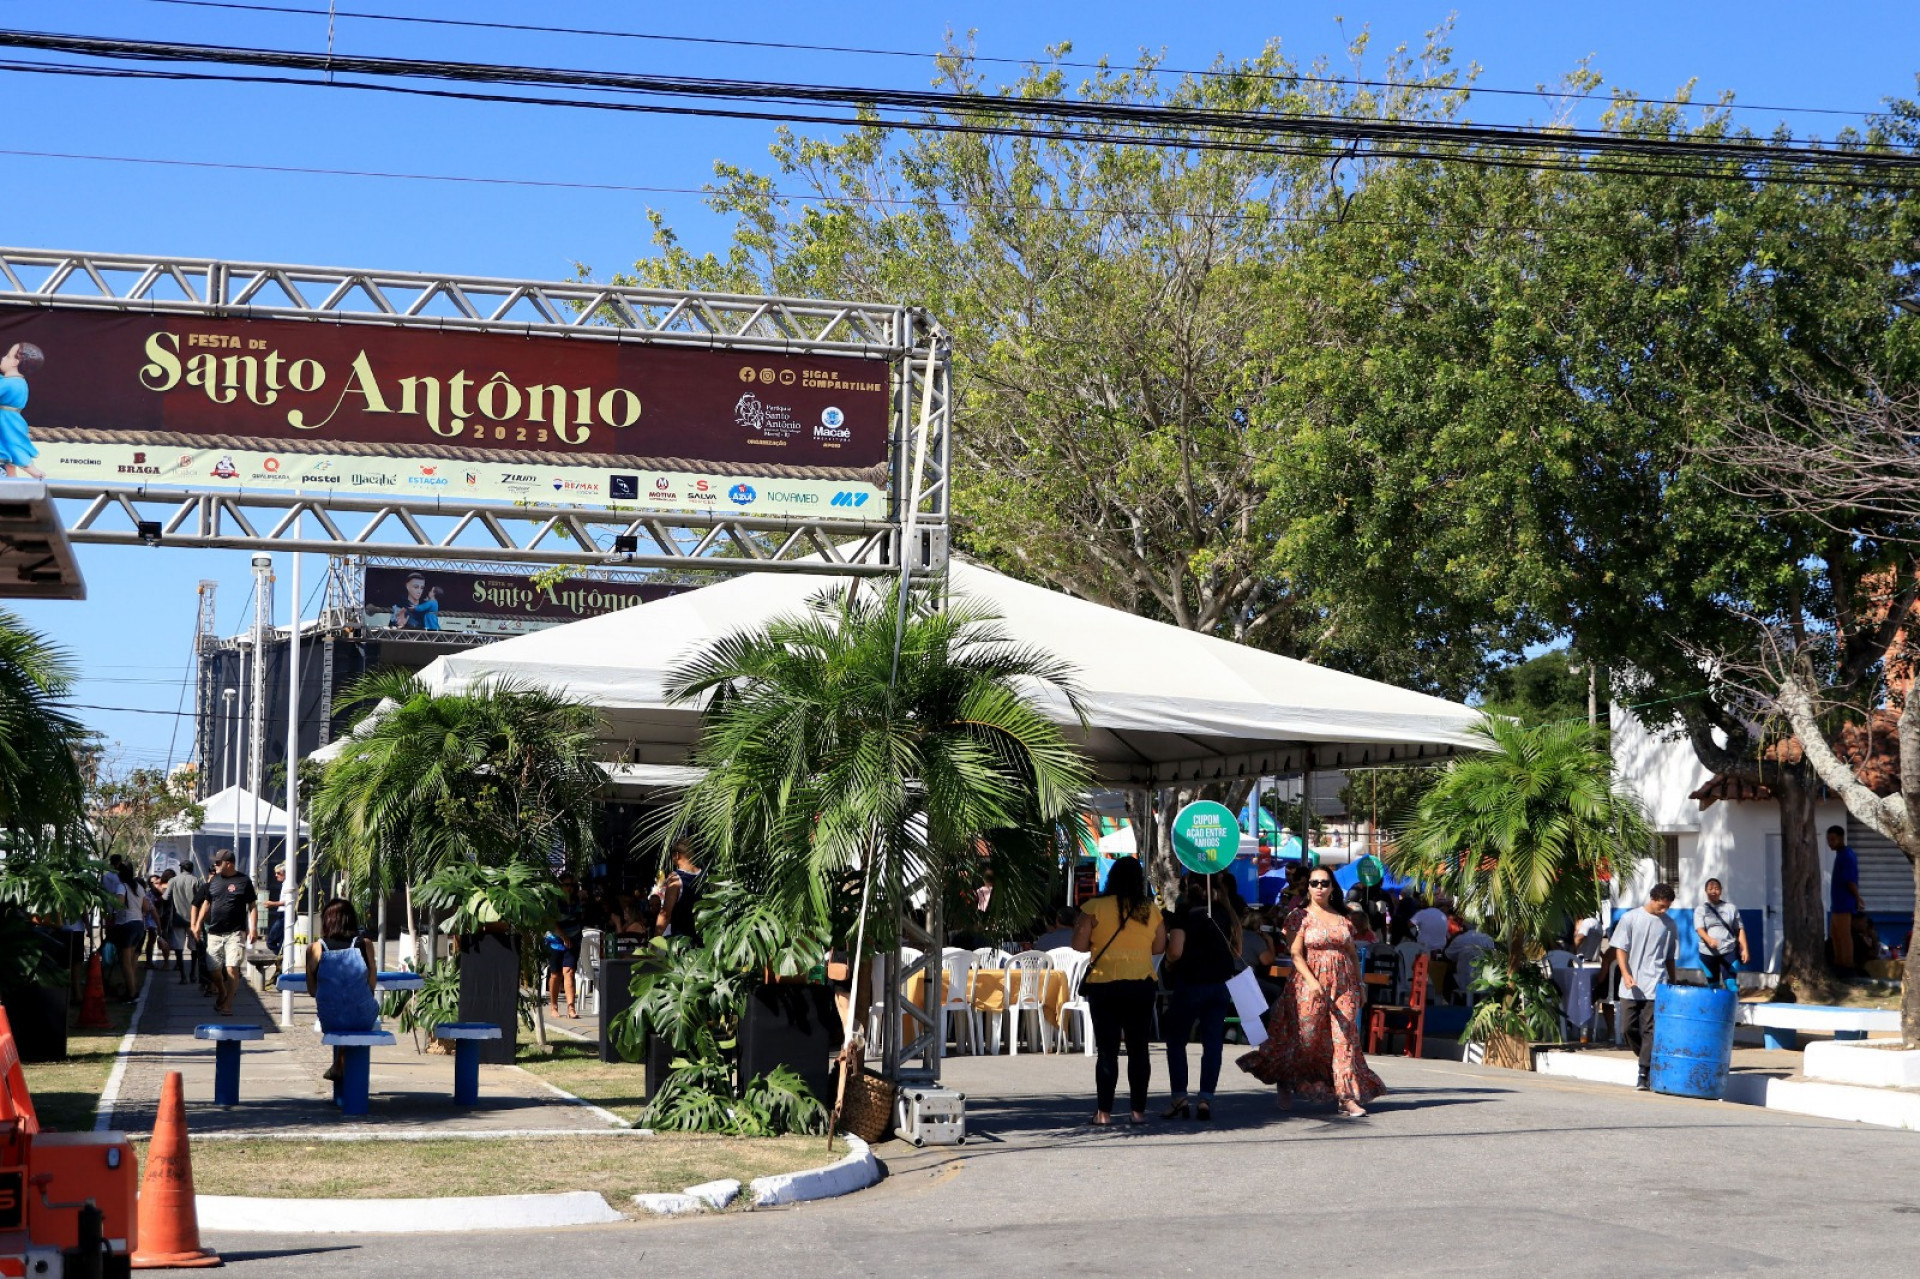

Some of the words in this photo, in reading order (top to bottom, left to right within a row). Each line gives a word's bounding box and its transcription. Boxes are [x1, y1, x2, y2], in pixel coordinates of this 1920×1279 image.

[188, 334, 242, 349] FESTA
[248, 339, 267, 350] DE
[802, 370, 829, 379] SIGA
[831, 371, 839, 380] E
[139, 331, 326, 406] Santo
[287, 349, 643, 445] Antônio
[802, 378, 882, 392] COMPARTILHE
[473, 424, 549, 442] 2023
[814, 425, 851, 438] Macaé
[60, 457, 102, 465] PATROCÍNIO
[117, 465, 161, 475] BRAGA
[302, 474, 340, 483] pastel
[351, 473, 397, 486] Macahé
[408, 476, 448, 485] ESTAÇÃO
[564, 481, 599, 490] RE/MAX
[648, 491, 677, 499] MOTIVA
[687, 492, 718, 500] SALVA
[767, 491, 819, 504] NOVAMED
[472, 580, 534, 608] Santo
[525, 585, 643, 615] Antônio
[1193, 814, 1220, 825] CUPOM
[1205, 827, 1228, 837] ENTRE
[1194, 837, 1220, 848] AMIGOS
